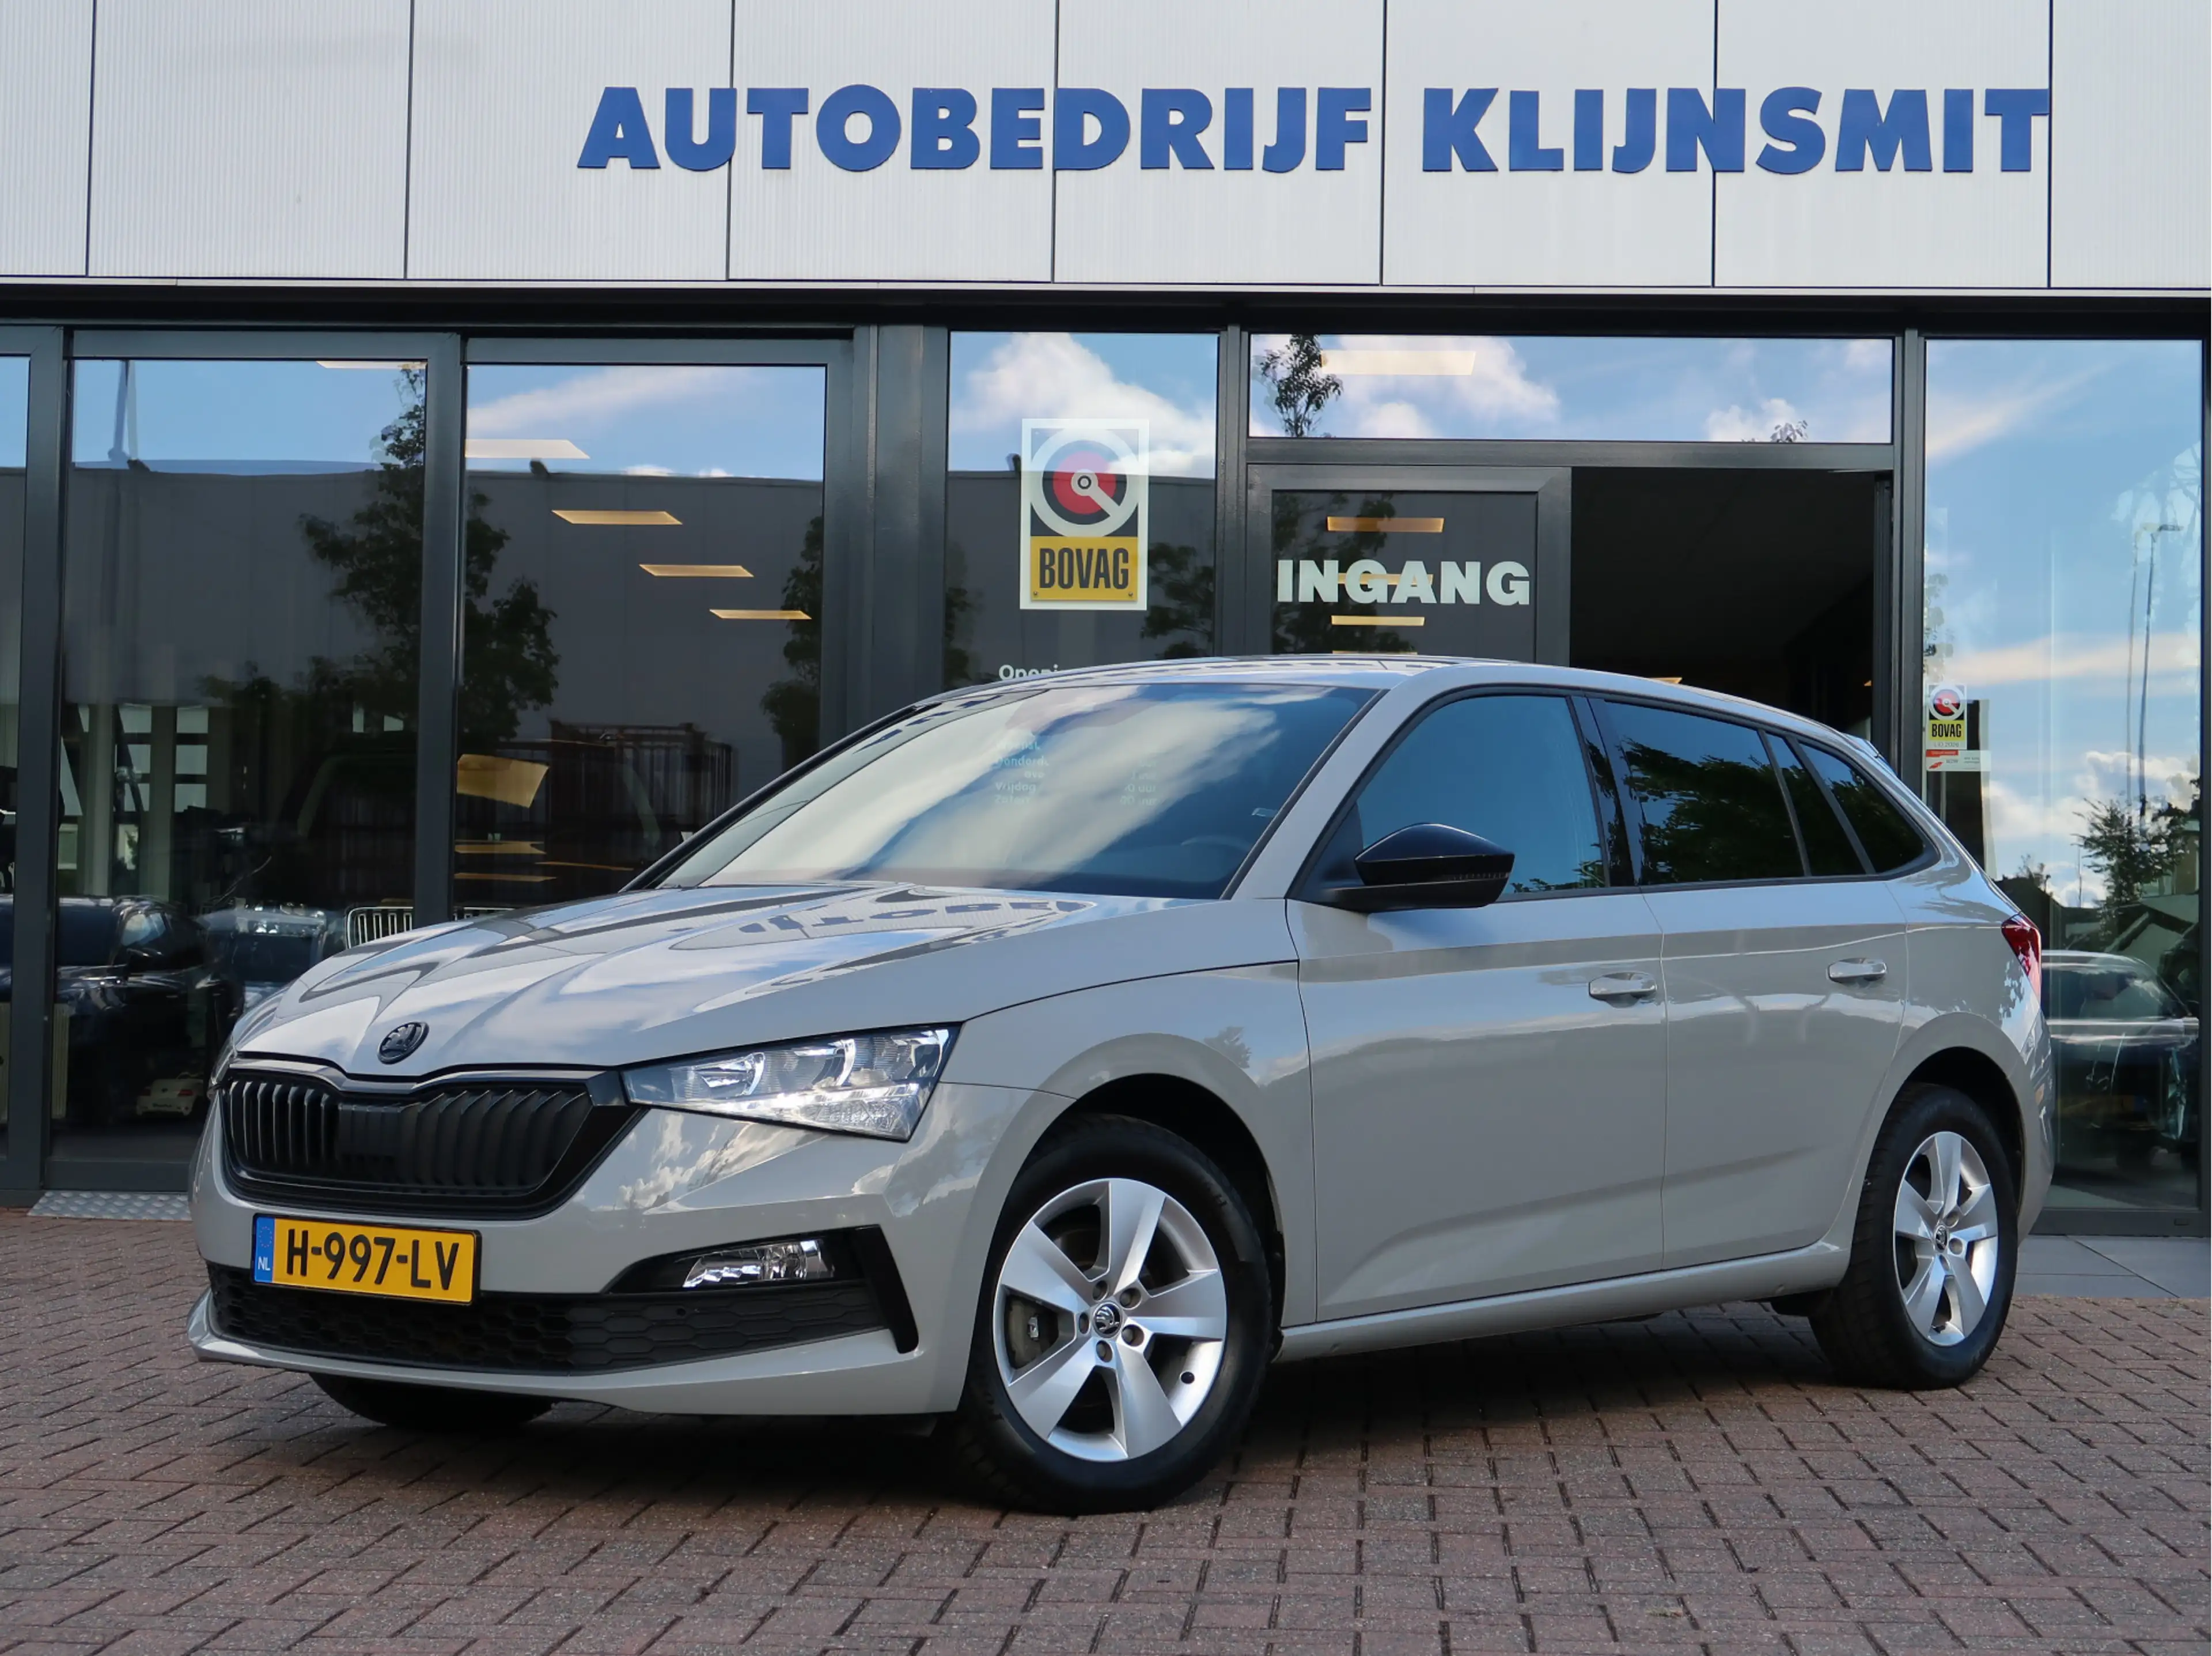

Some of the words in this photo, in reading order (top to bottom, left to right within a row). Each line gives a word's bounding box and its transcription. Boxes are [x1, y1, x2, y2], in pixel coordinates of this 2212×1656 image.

[577, 86, 1372, 173] AUTOBEDRIJF
[1422, 86, 2051, 174] KLIJNSMIT
[1039, 547, 1129, 589] BOVAG
[1277, 559, 1531, 606] INGANG
[1931, 724, 1962, 738] BOVAG
[258, 1256, 271, 1271] NL
[286, 1228, 460, 1291] H-997-LV
